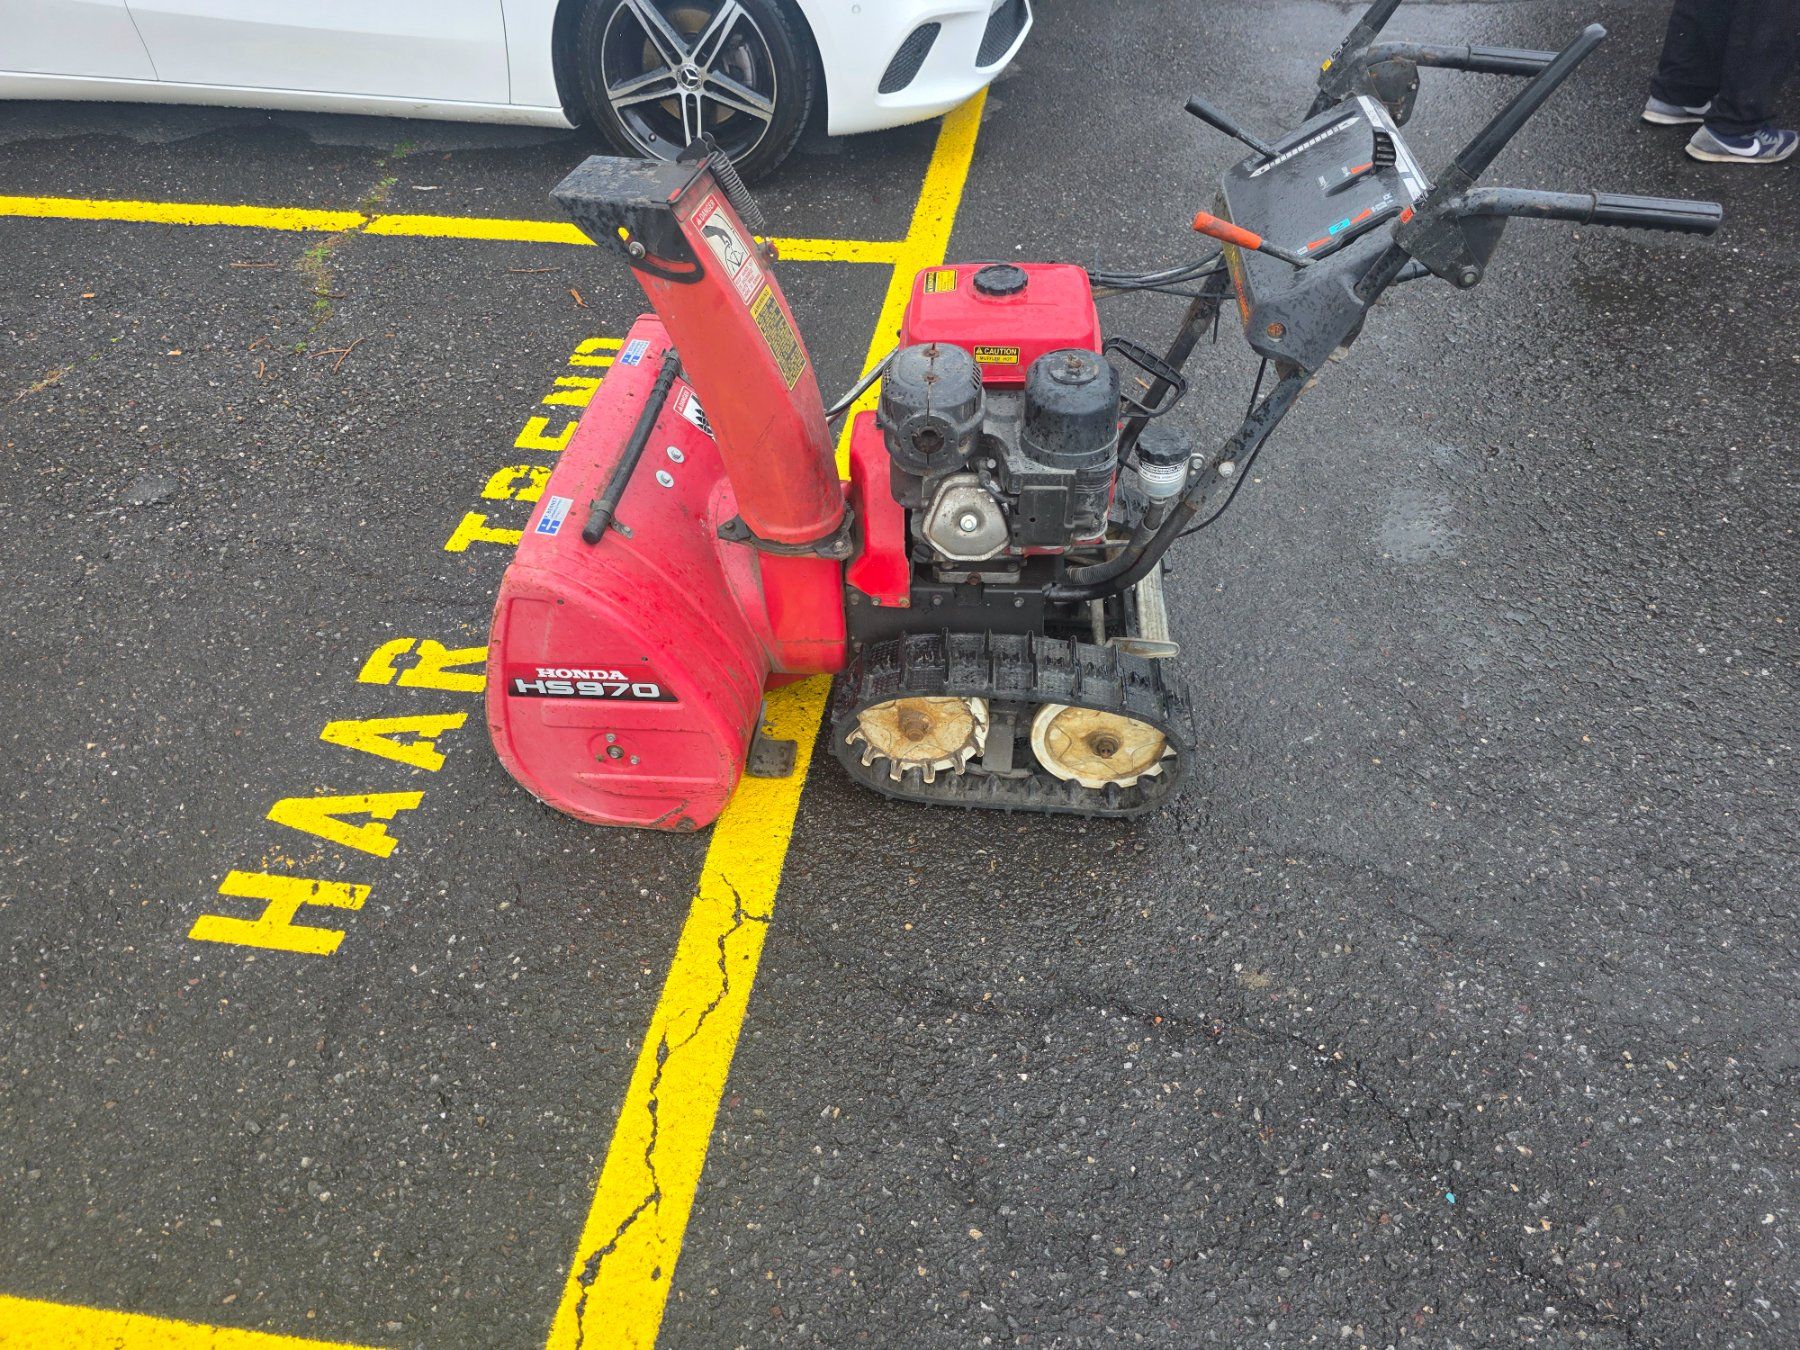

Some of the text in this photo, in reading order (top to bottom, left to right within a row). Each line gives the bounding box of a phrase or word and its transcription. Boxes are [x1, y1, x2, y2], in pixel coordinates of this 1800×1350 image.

[984, 347, 1017, 355] CAUTION
[536, 668, 628, 680] HONDA
[514, 679, 660, 698] HS970
[189, 638, 489, 956] HAAR
